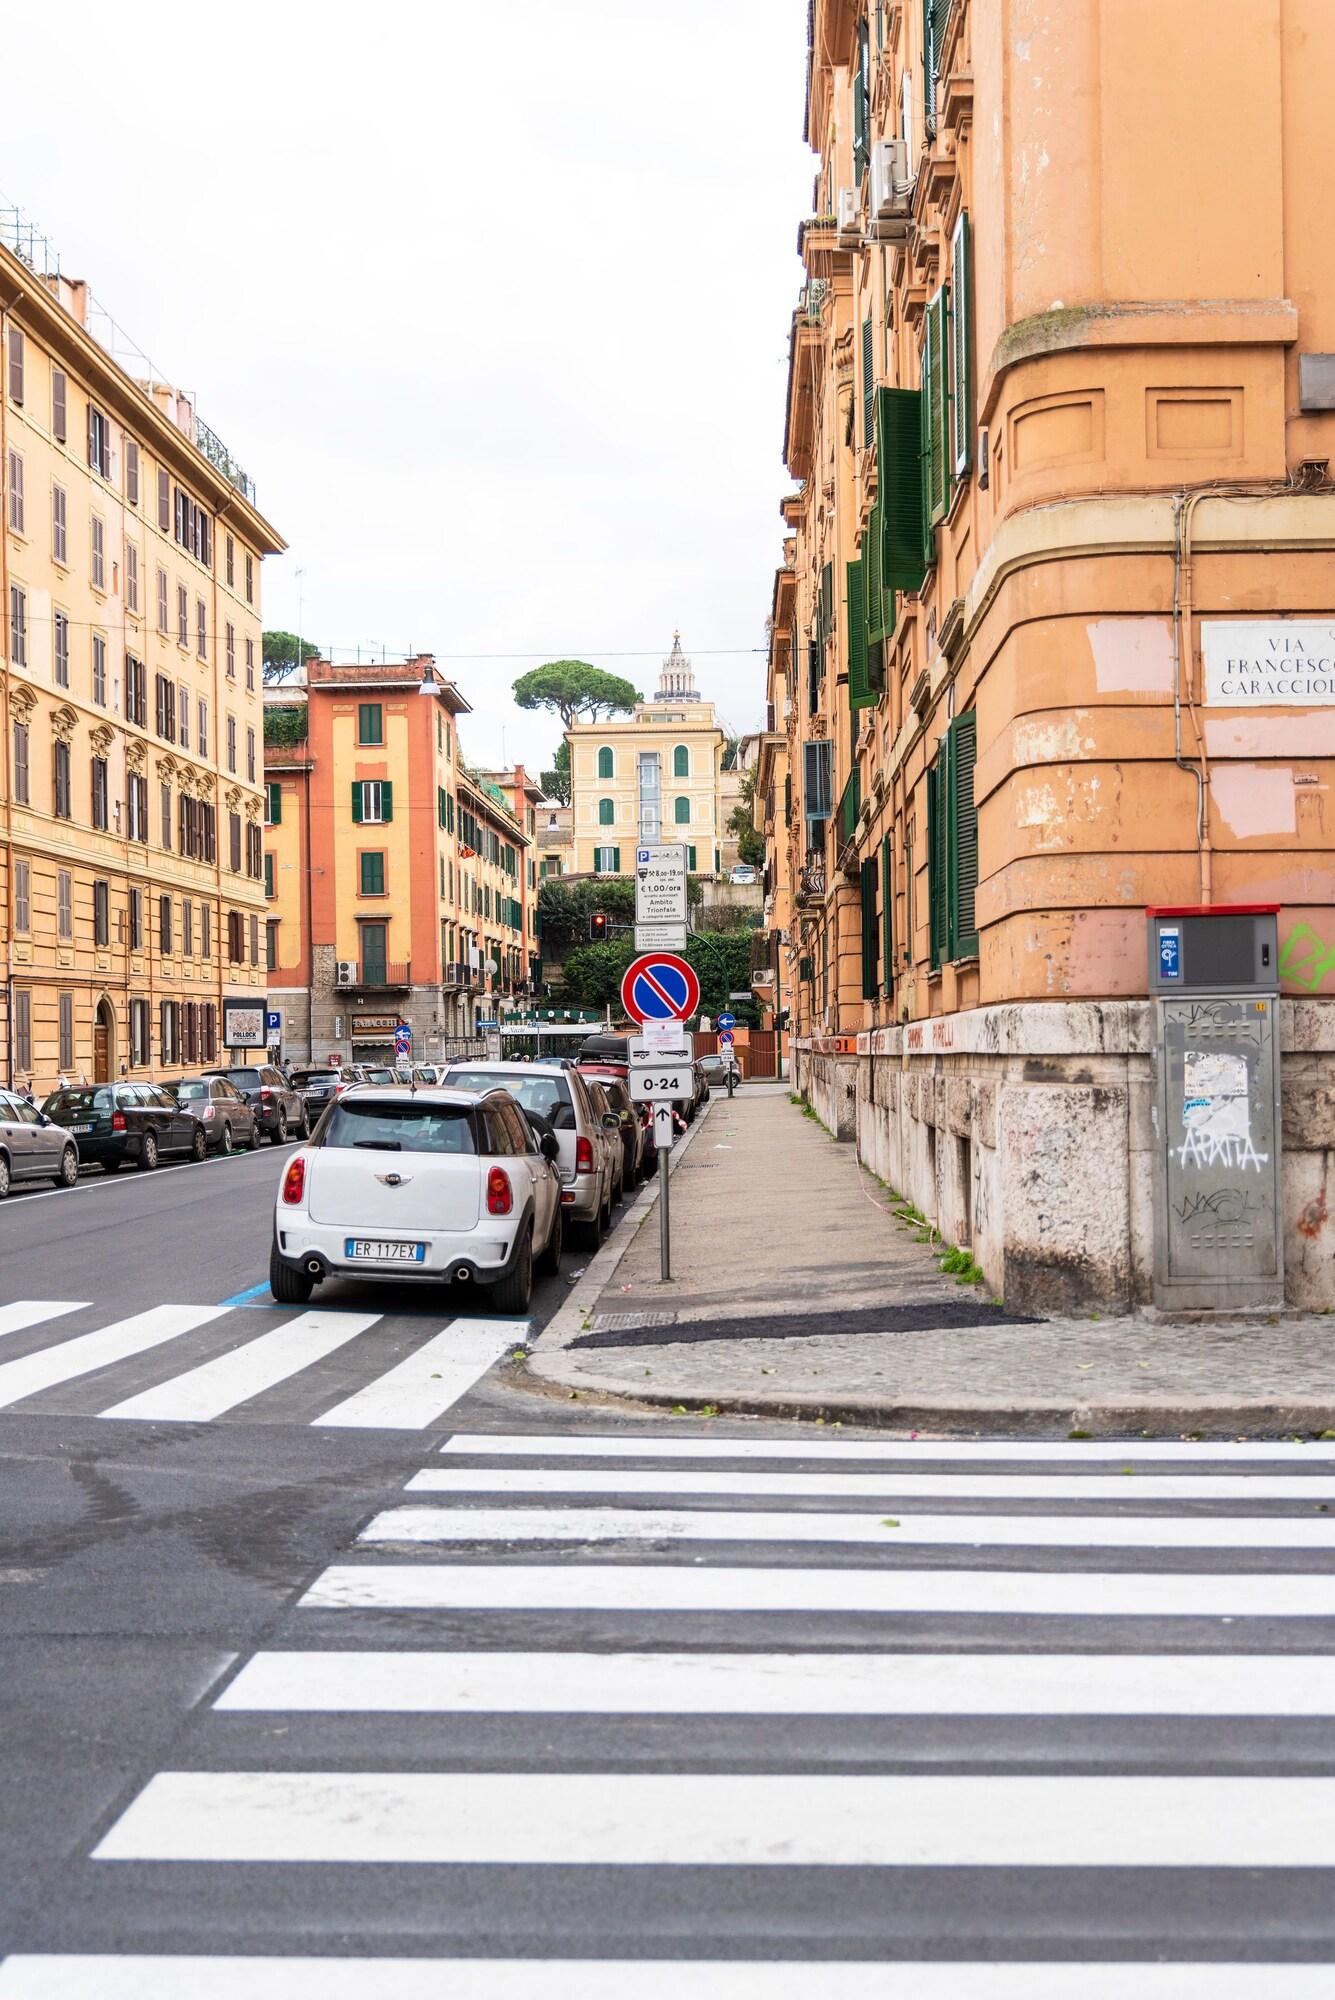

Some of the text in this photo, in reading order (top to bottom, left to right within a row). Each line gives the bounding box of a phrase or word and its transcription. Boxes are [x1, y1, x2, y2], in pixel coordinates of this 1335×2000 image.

[1268, 638, 1305, 653] VIA
[1227, 658, 1335, 674] FRANCESC
[640, 852, 648, 861] P
[270, 1015, 278, 1026] P
[521, 1010, 583, 1019] FIORI
[352, 1018, 397, 1028] TABACCHI
[643, 1078, 680, 1091] 0-24
[355, 1242, 371, 1256] ER
[377, 1244, 416, 1259] 117EX
